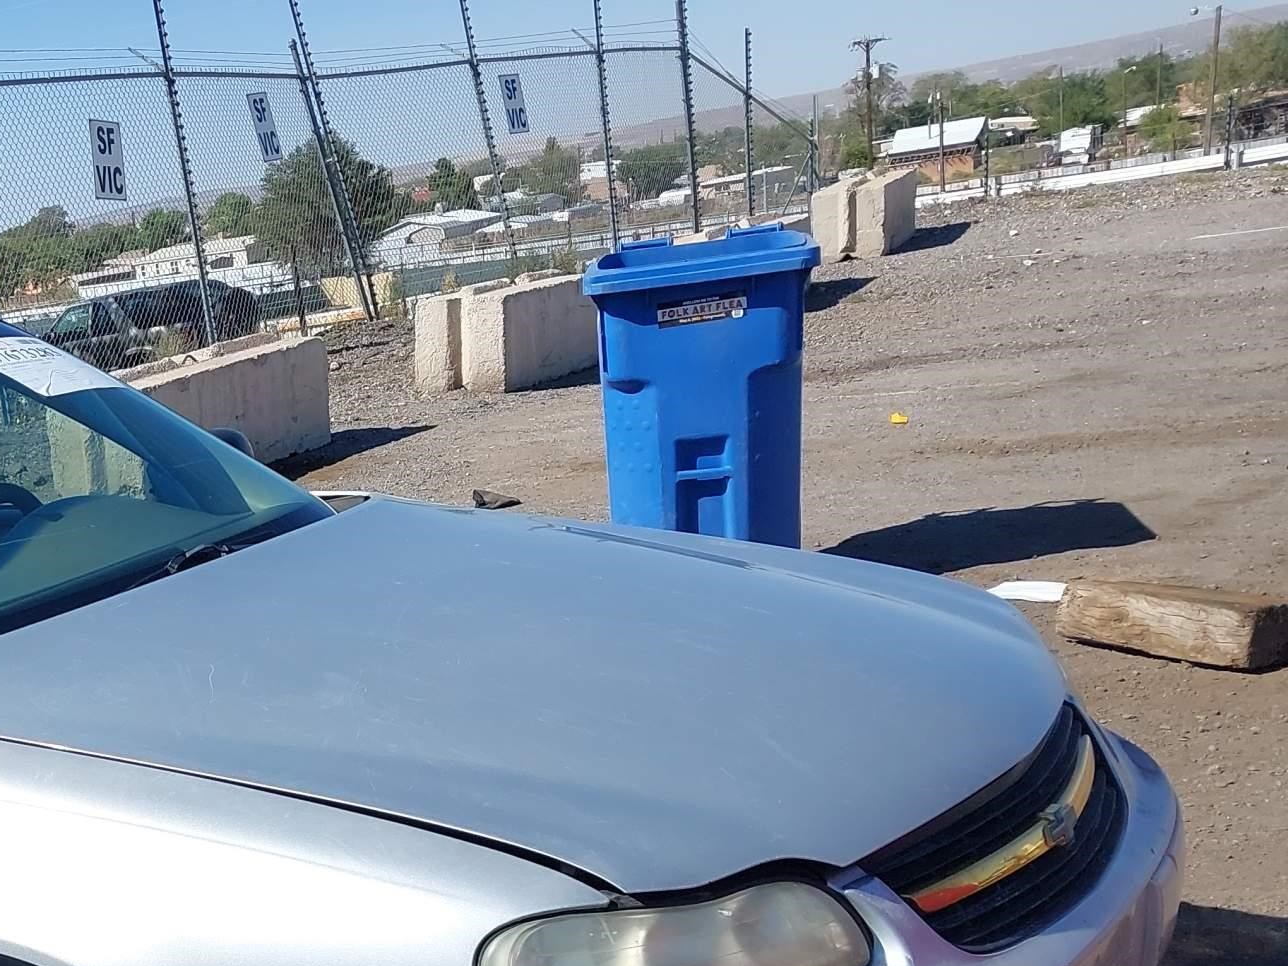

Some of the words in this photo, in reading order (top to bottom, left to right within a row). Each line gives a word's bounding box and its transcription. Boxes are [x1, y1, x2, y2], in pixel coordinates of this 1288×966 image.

[505, 79, 517, 100] SF
[253, 98, 267, 123] SF
[506, 107, 527, 129] VIC
[96, 126, 115, 155] SF
[258, 130, 280, 156] VIC
[95, 165, 124, 194] VIC
[661, 307, 689, 319] FOLK
[692, 303, 712, 314] ART
[716, 300, 744, 311] FLEA
